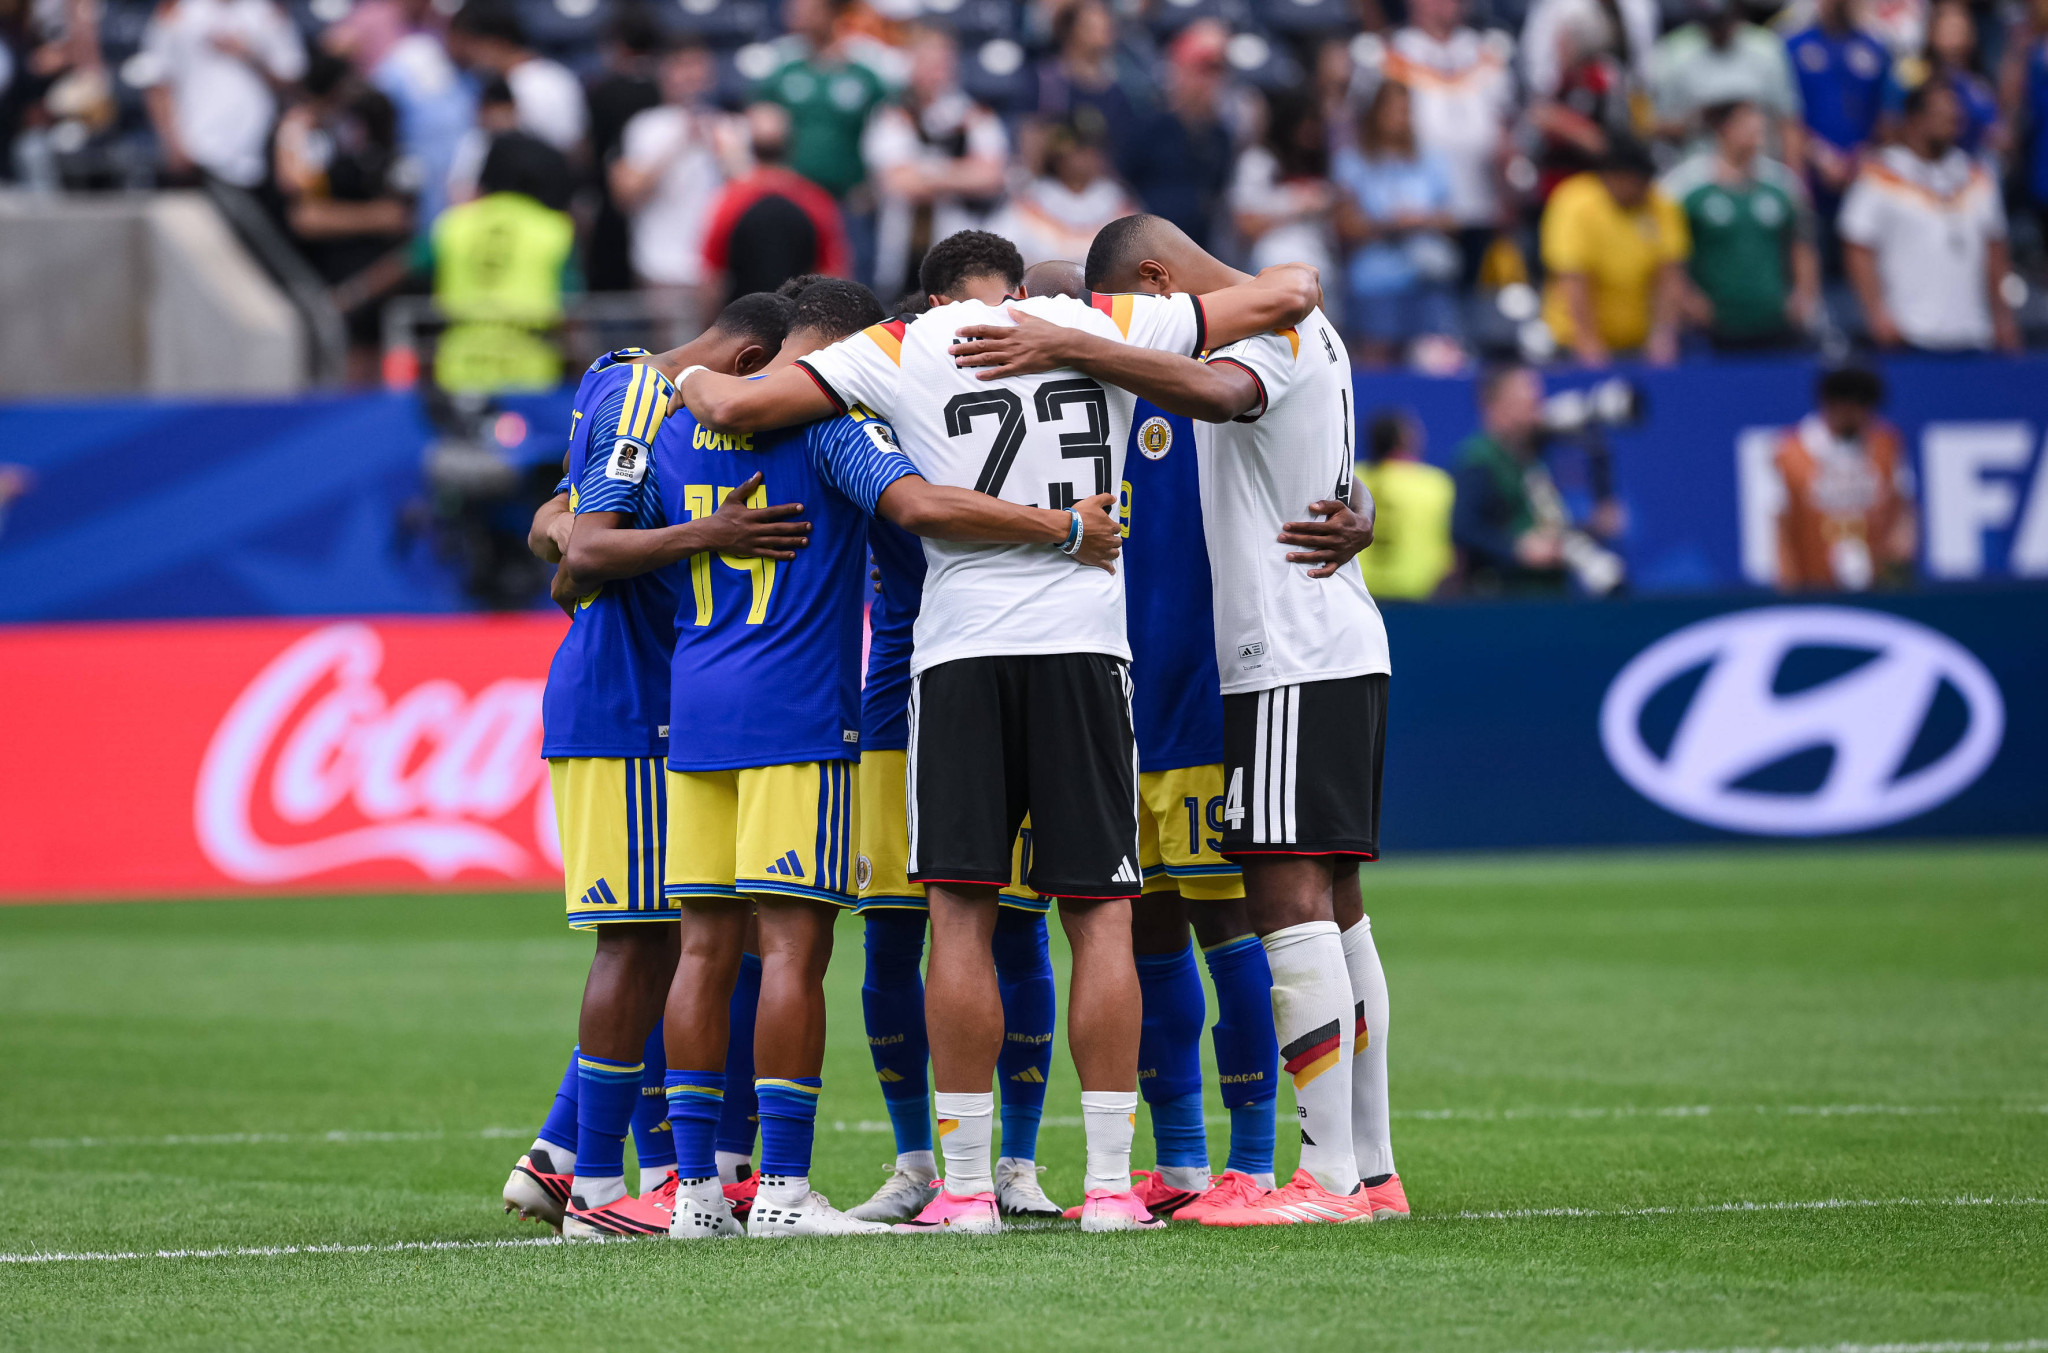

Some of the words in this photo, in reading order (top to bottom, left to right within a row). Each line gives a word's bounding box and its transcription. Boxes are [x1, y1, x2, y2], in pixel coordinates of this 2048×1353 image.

[943, 377, 1112, 517] 23
[1184, 795, 1225, 854] 19
[1223, 766, 1246, 831] 4
[1297, 1105, 1308, 1119] FB
